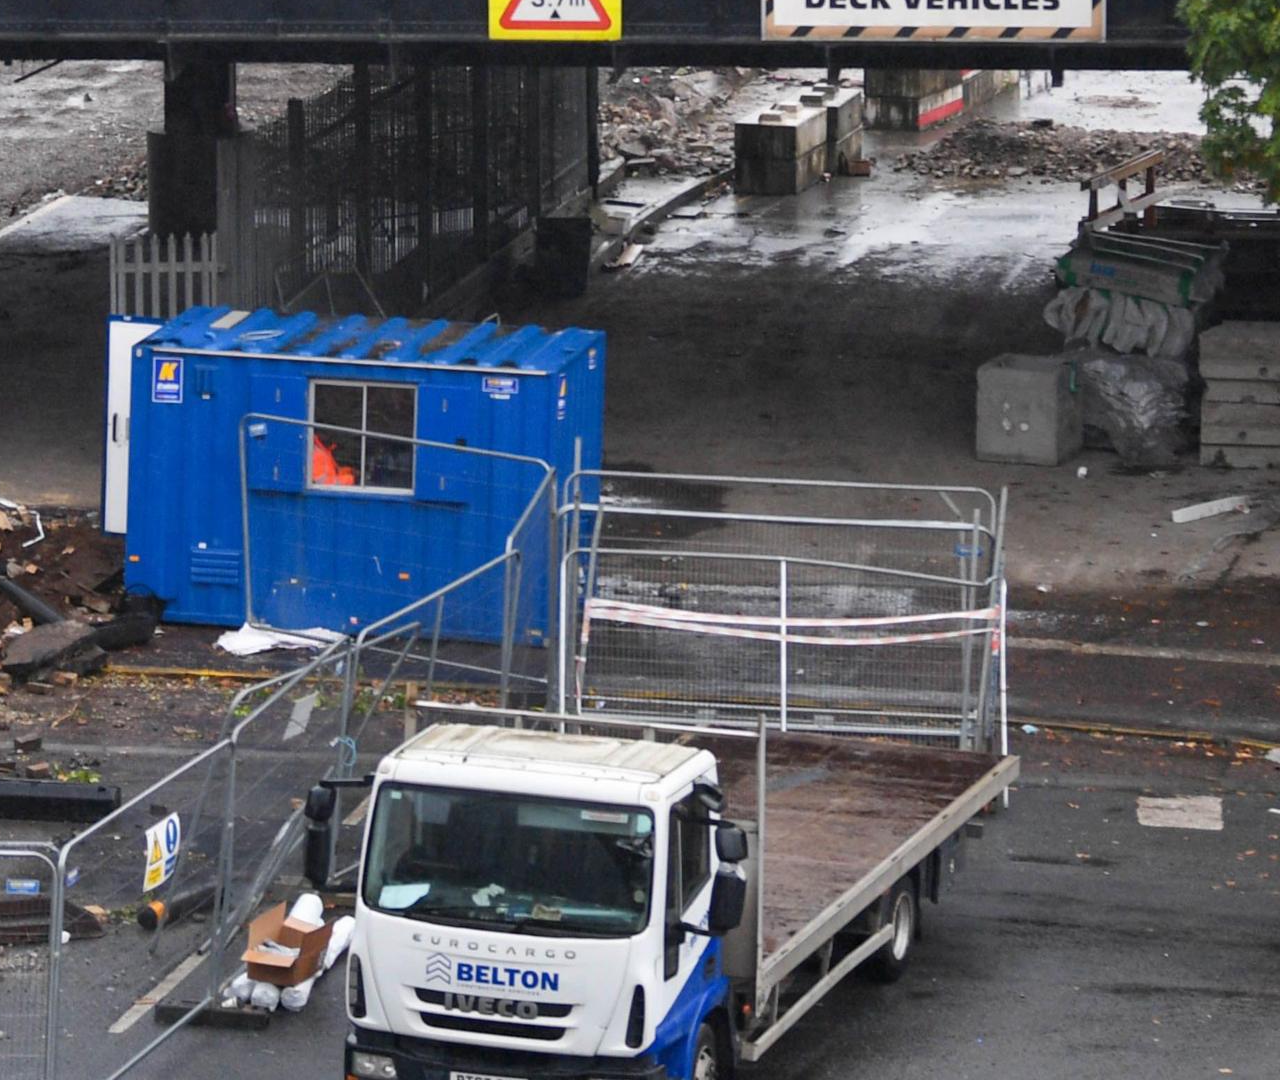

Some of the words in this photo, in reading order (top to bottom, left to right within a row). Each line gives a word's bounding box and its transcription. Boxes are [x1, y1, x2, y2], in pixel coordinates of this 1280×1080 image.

[412, 932, 577, 961] EUROCARGO
[456, 961, 559, 992] BELTON
[444, 991, 538, 1020] IVECO
